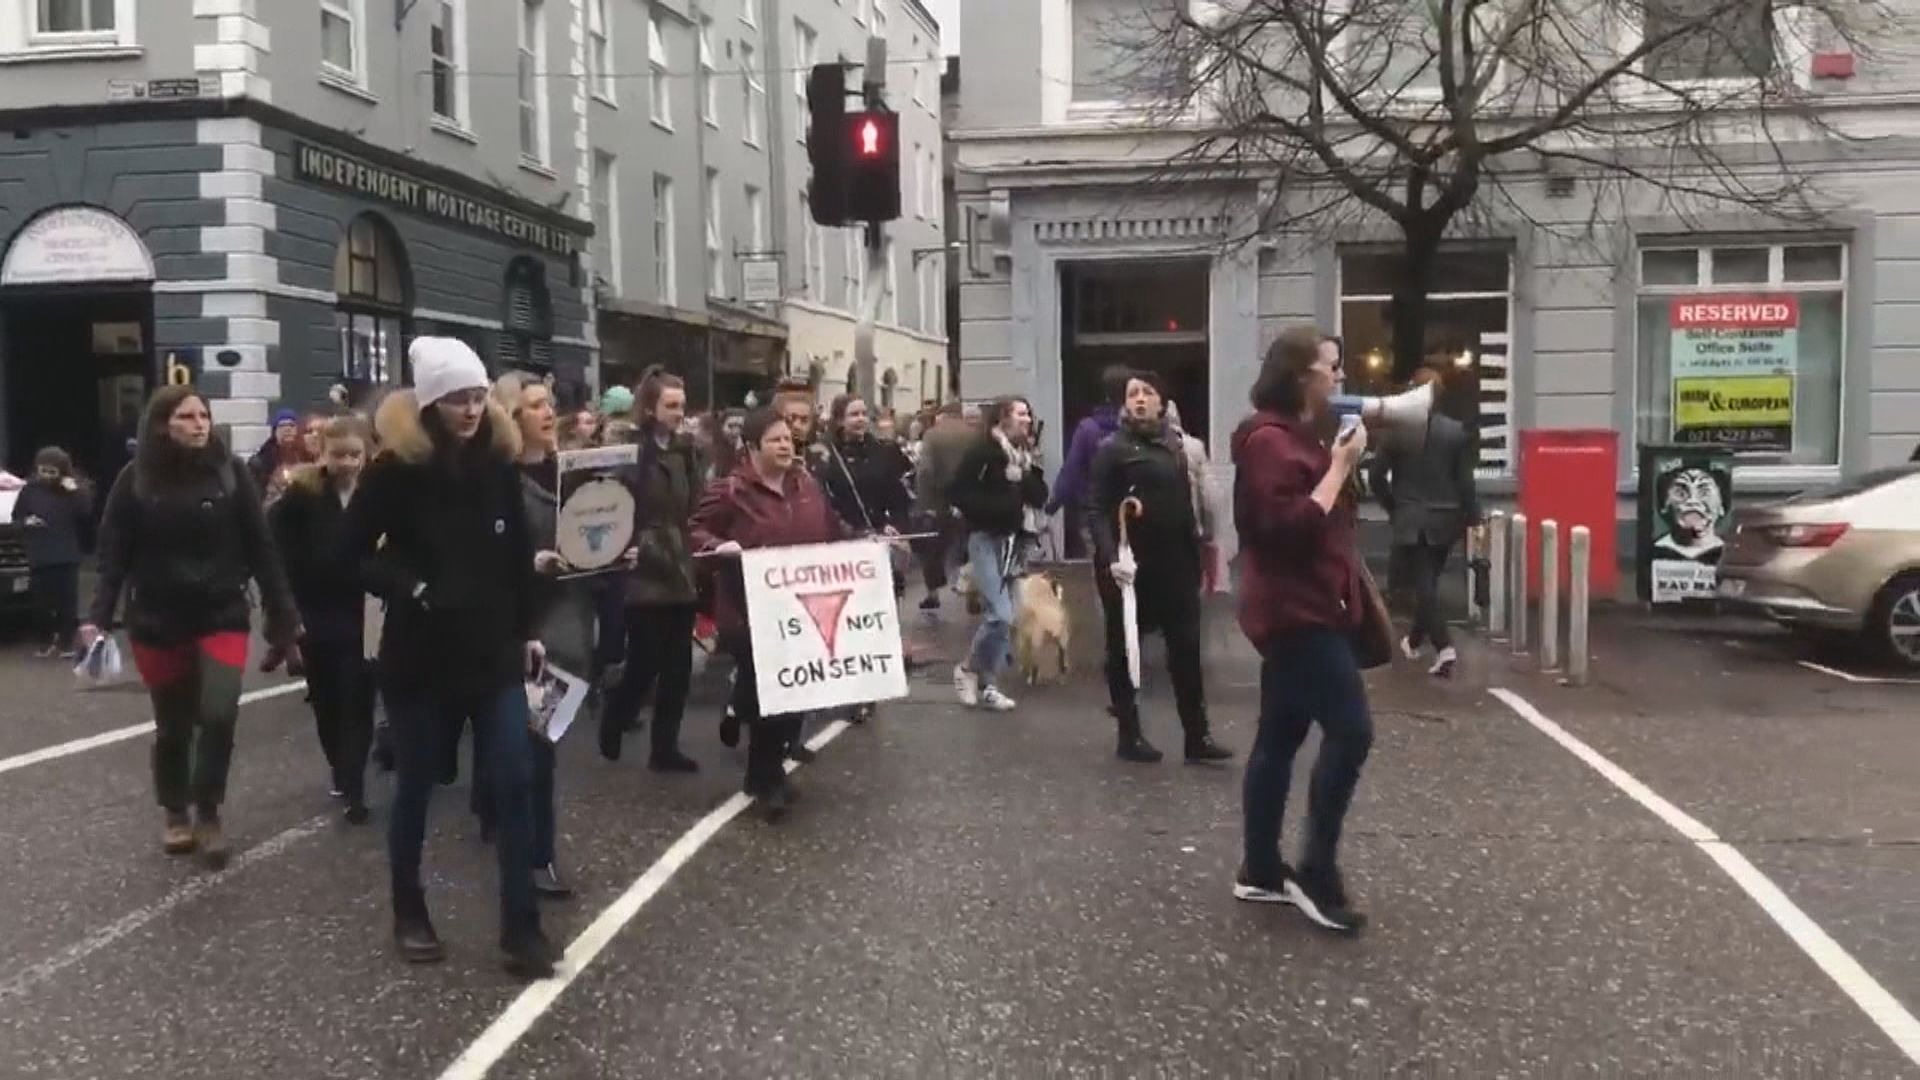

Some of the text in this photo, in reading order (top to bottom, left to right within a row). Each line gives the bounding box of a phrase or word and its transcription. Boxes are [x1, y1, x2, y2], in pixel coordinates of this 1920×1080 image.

[302, 146, 419, 207] INDEPENDENT
[426, 188, 500, 232] MORTGAGE
[503, 214, 547, 248] CENTRE
[1679, 304, 1789, 322] RESERVED
[1696, 341, 1774, 354] Office Suite
[764, 560, 878, 589] CLOTHING
[777, 611, 887, 640] IS NOT
[777, 653, 892, 688] CONSENT
